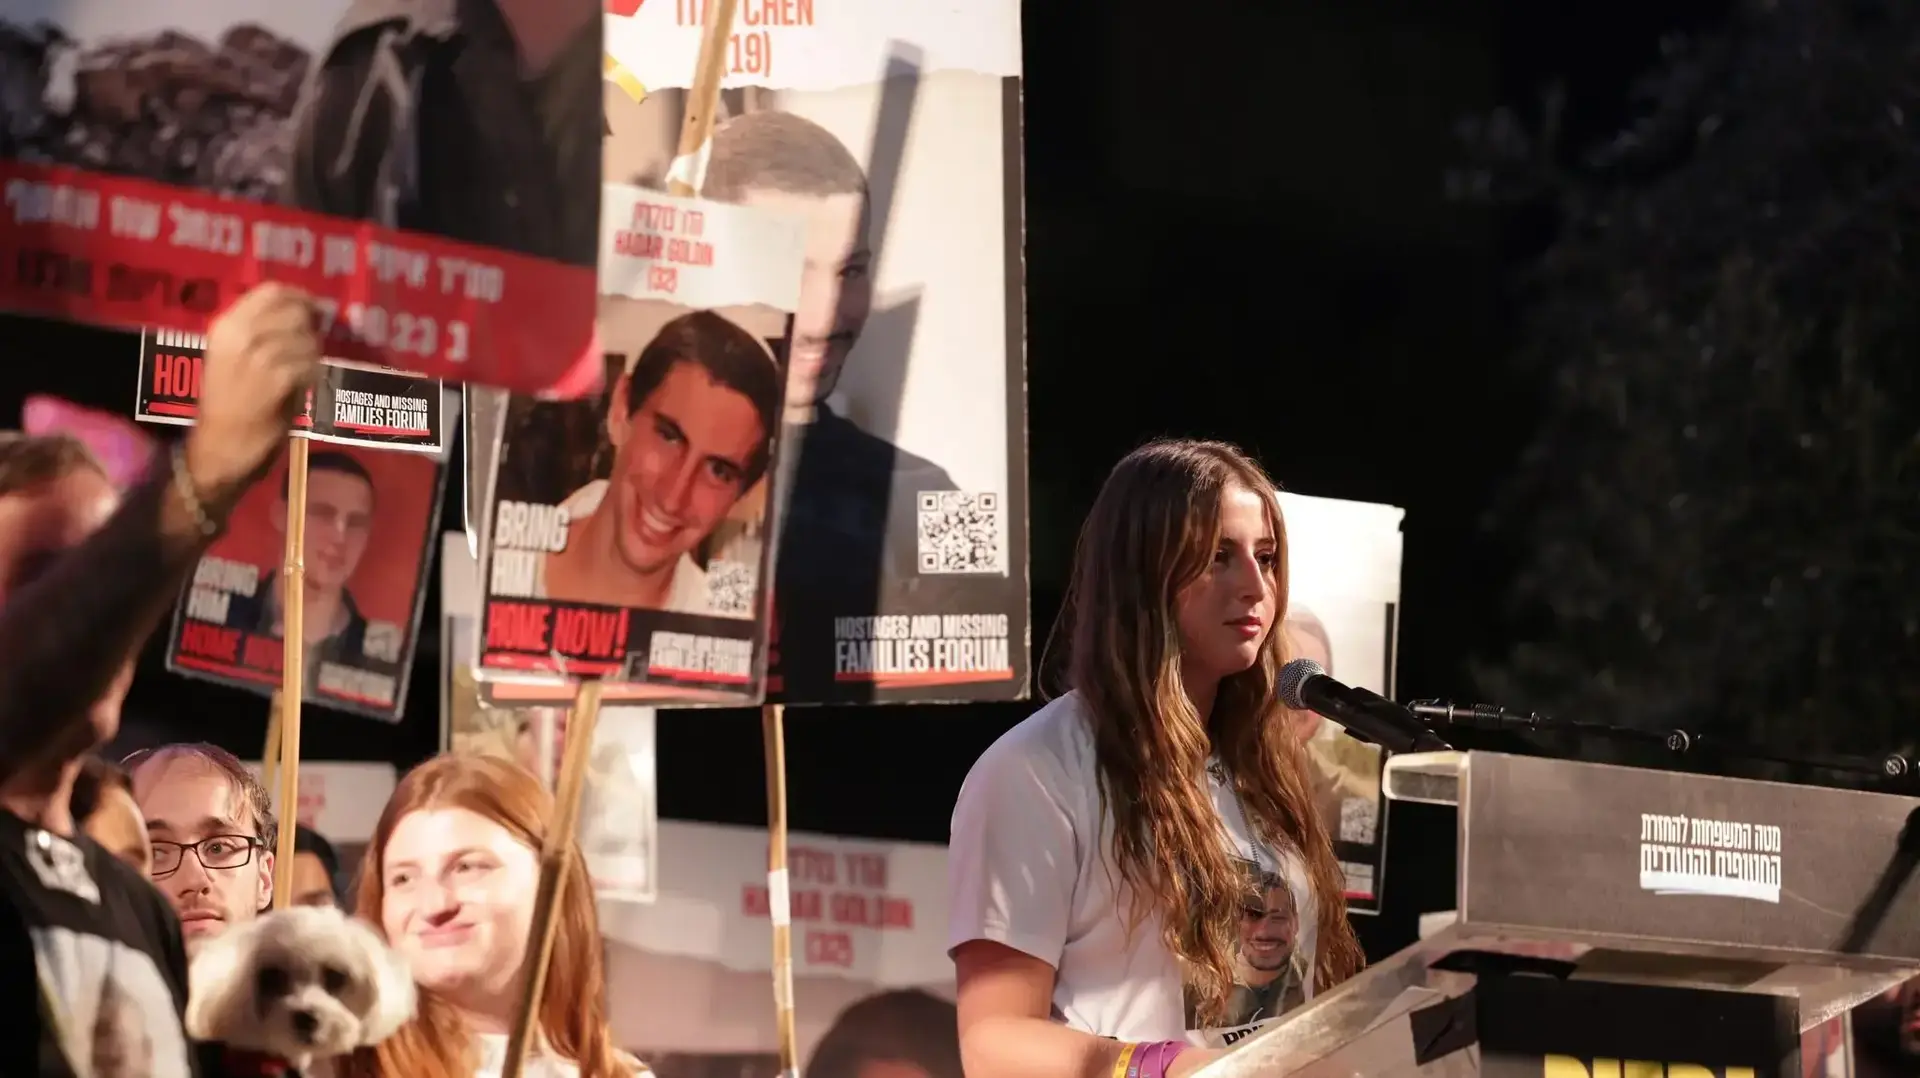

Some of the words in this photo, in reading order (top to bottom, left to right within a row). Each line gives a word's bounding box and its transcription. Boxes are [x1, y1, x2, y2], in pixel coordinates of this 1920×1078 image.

[743, 0, 814, 26] CHEN
[335, 388, 373, 407] HOSTAGES
[374, 395, 390, 409] AND
[391, 396, 428, 412] MISSING
[335, 402, 383, 427] FAMILIES
[386, 408, 428, 431] FORUM
[496, 500, 569, 553] BRING
[487, 601, 551, 651] HOME
[552, 606, 629, 658] NOW!
[834, 615, 910, 639] HOSTAGES
[911, 614, 941, 639] AND
[942, 613, 1008, 638] MISSING
[835, 640, 930, 673] FAMILIES
[933, 638, 1009, 672] FORUM
[1641, 813, 1689, 845] להחזרת
[1691, 818, 1752, 851] המשפחות
[1754, 824, 1781, 853] מטה
[1640, 843, 1711, 877] והנעדרים
[1715, 849, 1781, 887] החטופים
